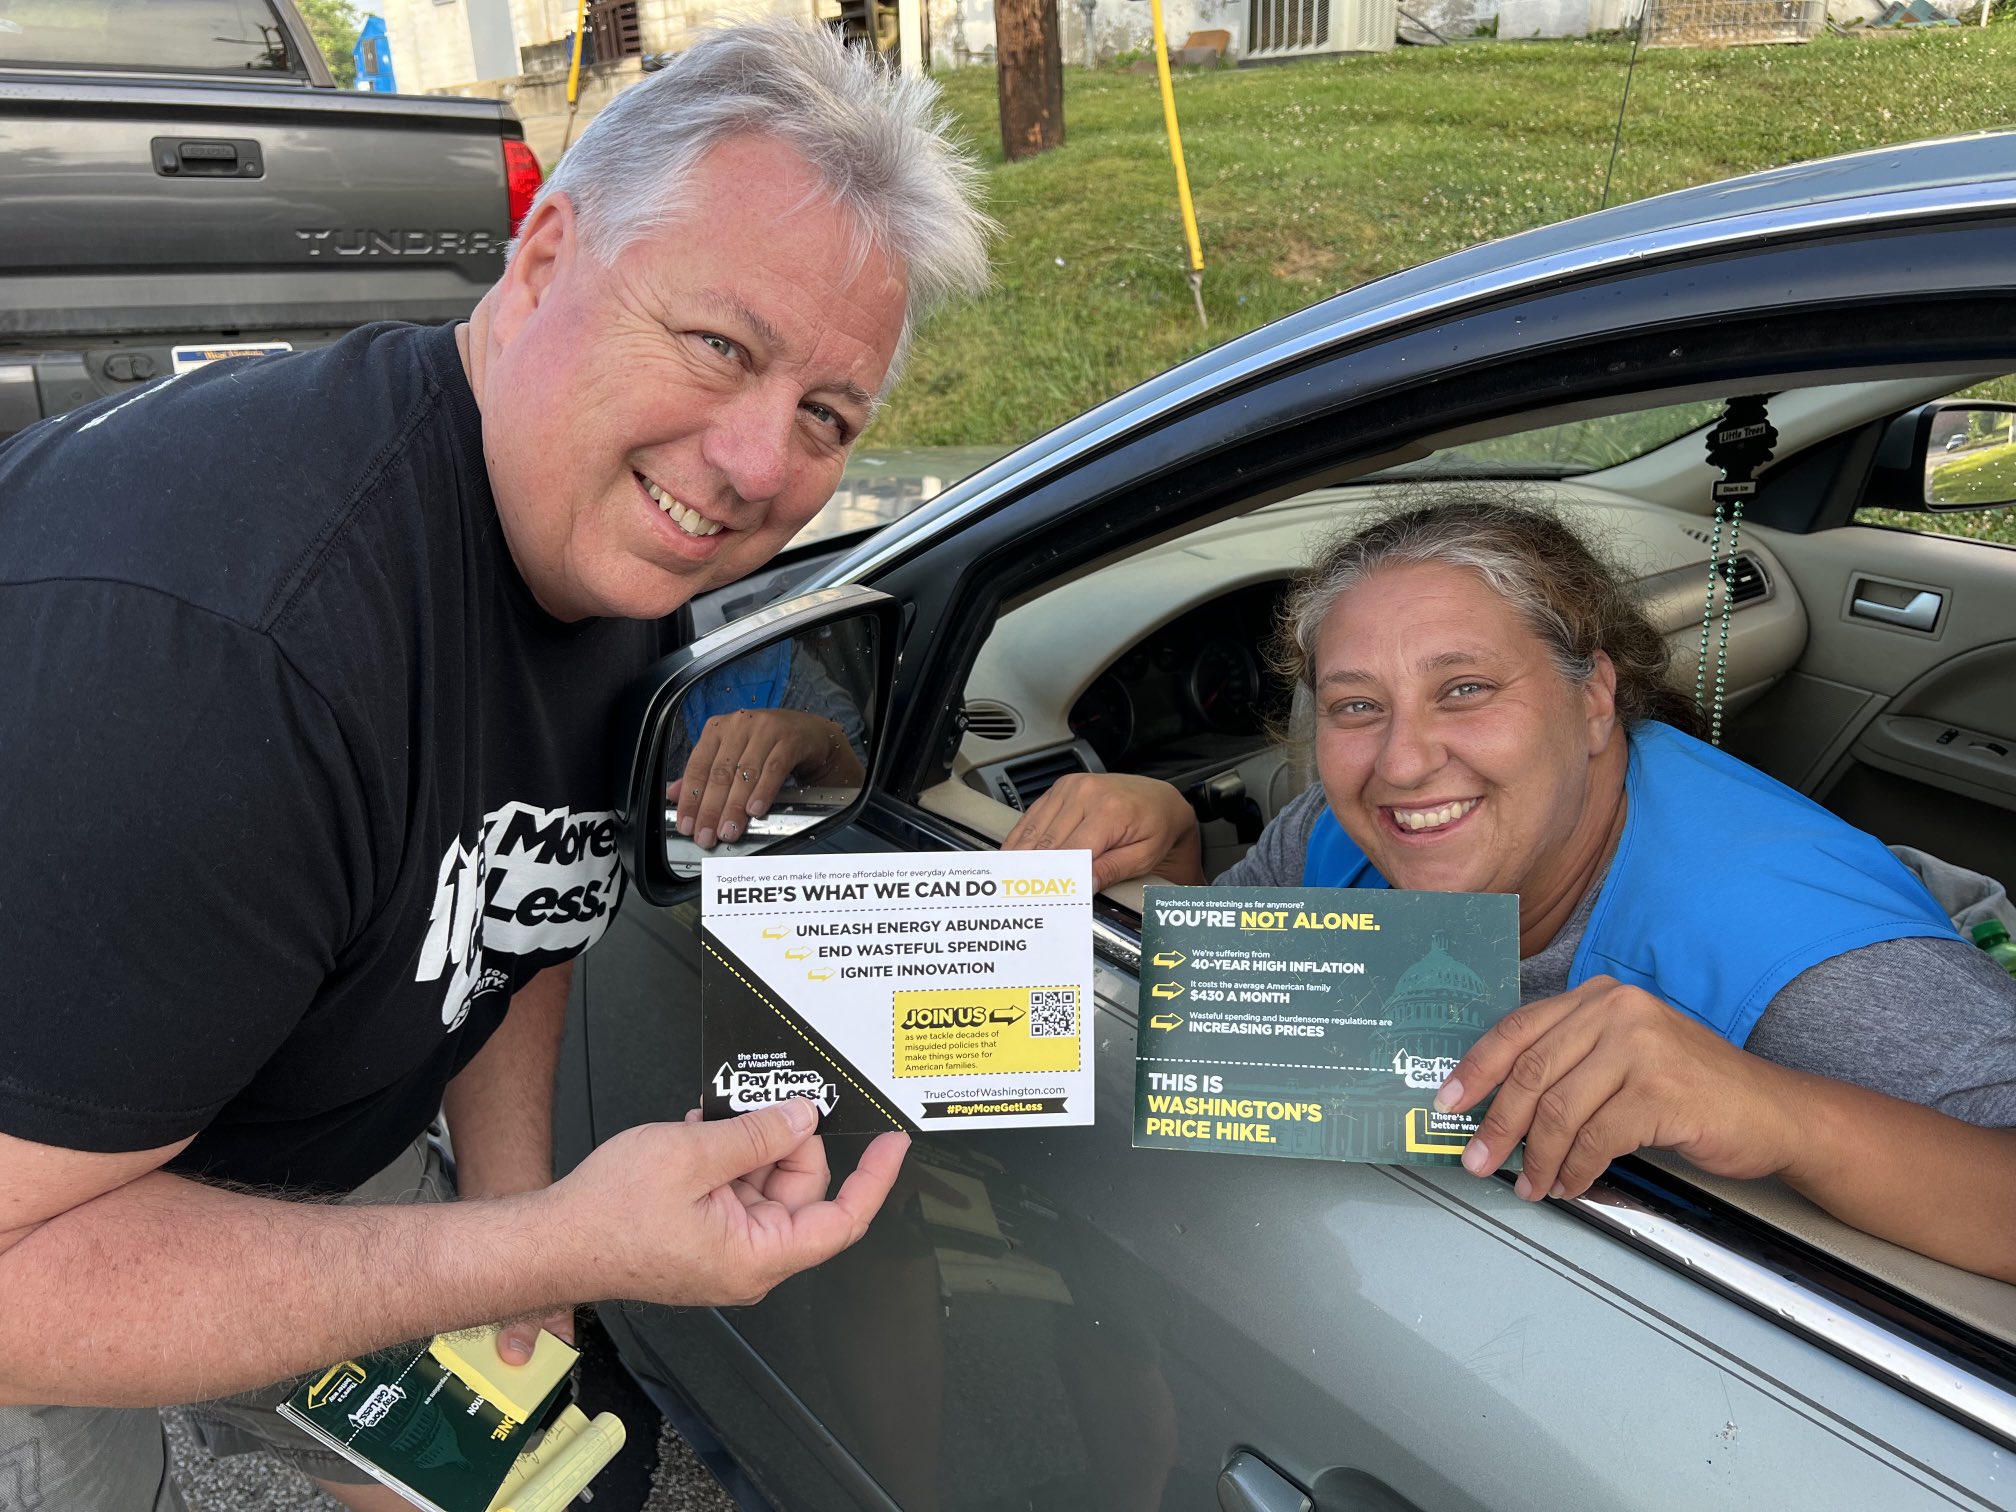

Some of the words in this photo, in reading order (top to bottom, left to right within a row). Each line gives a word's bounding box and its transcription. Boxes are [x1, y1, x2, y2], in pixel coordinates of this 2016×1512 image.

[296, 229, 498, 255] TUNDRA
[1721, 430, 1742, 442] Little
[1744, 425, 1764, 437] Trees
[495, 809, 618, 866] More.
[716, 875, 757, 884] Together,
[772, 874, 788, 882] can
[790, 872, 813, 880] make
[814, 872, 827, 880] life
[829, 872, 851, 880] more
[852, 870, 895, 878] affordable
[896, 869, 907, 878] for
[910, 868, 946, 878] everyday
[948, 868, 992, 876] Americans.
[483, 866, 607, 927] Less.
[717, 885, 797, 905] HERE'S
[802, 883, 869, 902] WHAT
[874, 882, 910, 900] WE
[914, 880, 961, 898] CAN
[966, 880, 997, 897] DO
[1002, 877, 1077, 896] TODAY:
[1155, 899, 1190, 908] Paycheck
[1191, 900, 1204, 908] not
[1205, 900, 1243, 910] stretching
[1266, 901, 1305, 910] anymore?
[796, 922, 872, 937] UNLEASH
[877, 920, 942, 934] ENERGY
[945, 917, 1044, 932] ABUNDANCE
[1155, 910, 1236, 928] YOU'RE
[1240, 911, 1288, 929] NOT
[1292, 912, 1381, 931] ALONE.
[818, 945, 853, 958] END
[857, 942, 944, 957] WASTEFUL
[947, 939, 1028, 954] SPENDING
[1192, 950, 1214, 958] We're
[1215, 950, 1250, 960] suffering
[1252, 950, 1271, 958] from
[484, 968, 509, 980] FOR
[840, 965, 893, 979] IGNITE
[897, 961, 995, 976] INNOVATION
[1190, 960, 1251, 972] 40-YEAR
[1252, 960, 1287, 973] HIGH
[1290, 962, 1365, 974] INFLATION
[474, 977, 505, 993] RITY.
[1234, 983, 1266, 992] average
[1266, 982, 1305, 991] American
[1306, 984, 1332, 993] family
[1190, 990, 1224, 1002] $430
[1226, 992, 1238, 1002] A
[1240, 992, 1290, 1004] MONTH
[901, 1007, 955, 1029] JOIN
[956, 1006, 987, 1027] US
[1188, 1012, 1224, 1020] Wasteful
[1224, 1013, 1261, 1024] spending
[1262, 1014, 1278, 1022] and
[1278, 1015, 1330, 1024] burdensome
[1331, 1016, 1378, 1028] regulations
[1378, 1019, 1393, 1028] are
[930, 1032, 954, 1040] tackle
[956, 1030, 990, 1039] decades
[991, 1030, 1000, 1038] of
[1188, 1022, 1272, 1036] INCREASING
[1275, 1024, 1326, 1038] PRICES
[904, 1042, 948, 1052] misguided
[948, 1041, 979, 1050] policies
[981, 1040, 997, 1049] that
[752, 1052, 769, 1060] true
[904, 1053, 927, 1062] make
[928, 1052, 954, 1062] things
[956, 1052, 980, 1060] worse
[981, 1050, 993, 1059] for
[738, 1061, 747, 1069] of
[748, 1060, 795, 1068] Washington
[904, 1063, 944, 1072] American
[946, 1062, 978, 1070] families.
[1411, 1058, 1438, 1070] Pay
[1438, 1058, 1460, 1070] Mo
[738, 1073, 771, 1088] Pay
[774, 1072, 821, 1085] More.
[1148, 1072, 1198, 1092] THIS
[1202, 1074, 1224, 1094] IS
[1411, 1071, 1438, 1082] Get
[738, 1088, 772, 1103] Get
[775, 1088, 821, 1102] Less.
[924, 1086, 1066, 1100] TrueCostofWashington.com
[946, 1102, 1043, 1116] #PayMoreGetLess
[1147, 1094, 1323, 1123] WASHINGTON'S
[1430, 1112, 1464, 1122] There's
[1146, 1118, 1211, 1140] PRICE
[1216, 1120, 1278, 1144] HIKE.
[1430, 1120, 1460, 1130] better
[1461, 1122, 1480, 1132] way
[373, 1389, 389, 1404] Get
[382, 1394, 397, 1409] Pay
[466, 1394, 485, 1417] TION
[367, 1407, 387, 1426] More.
[490, 1415, 517, 1442] ONE.
